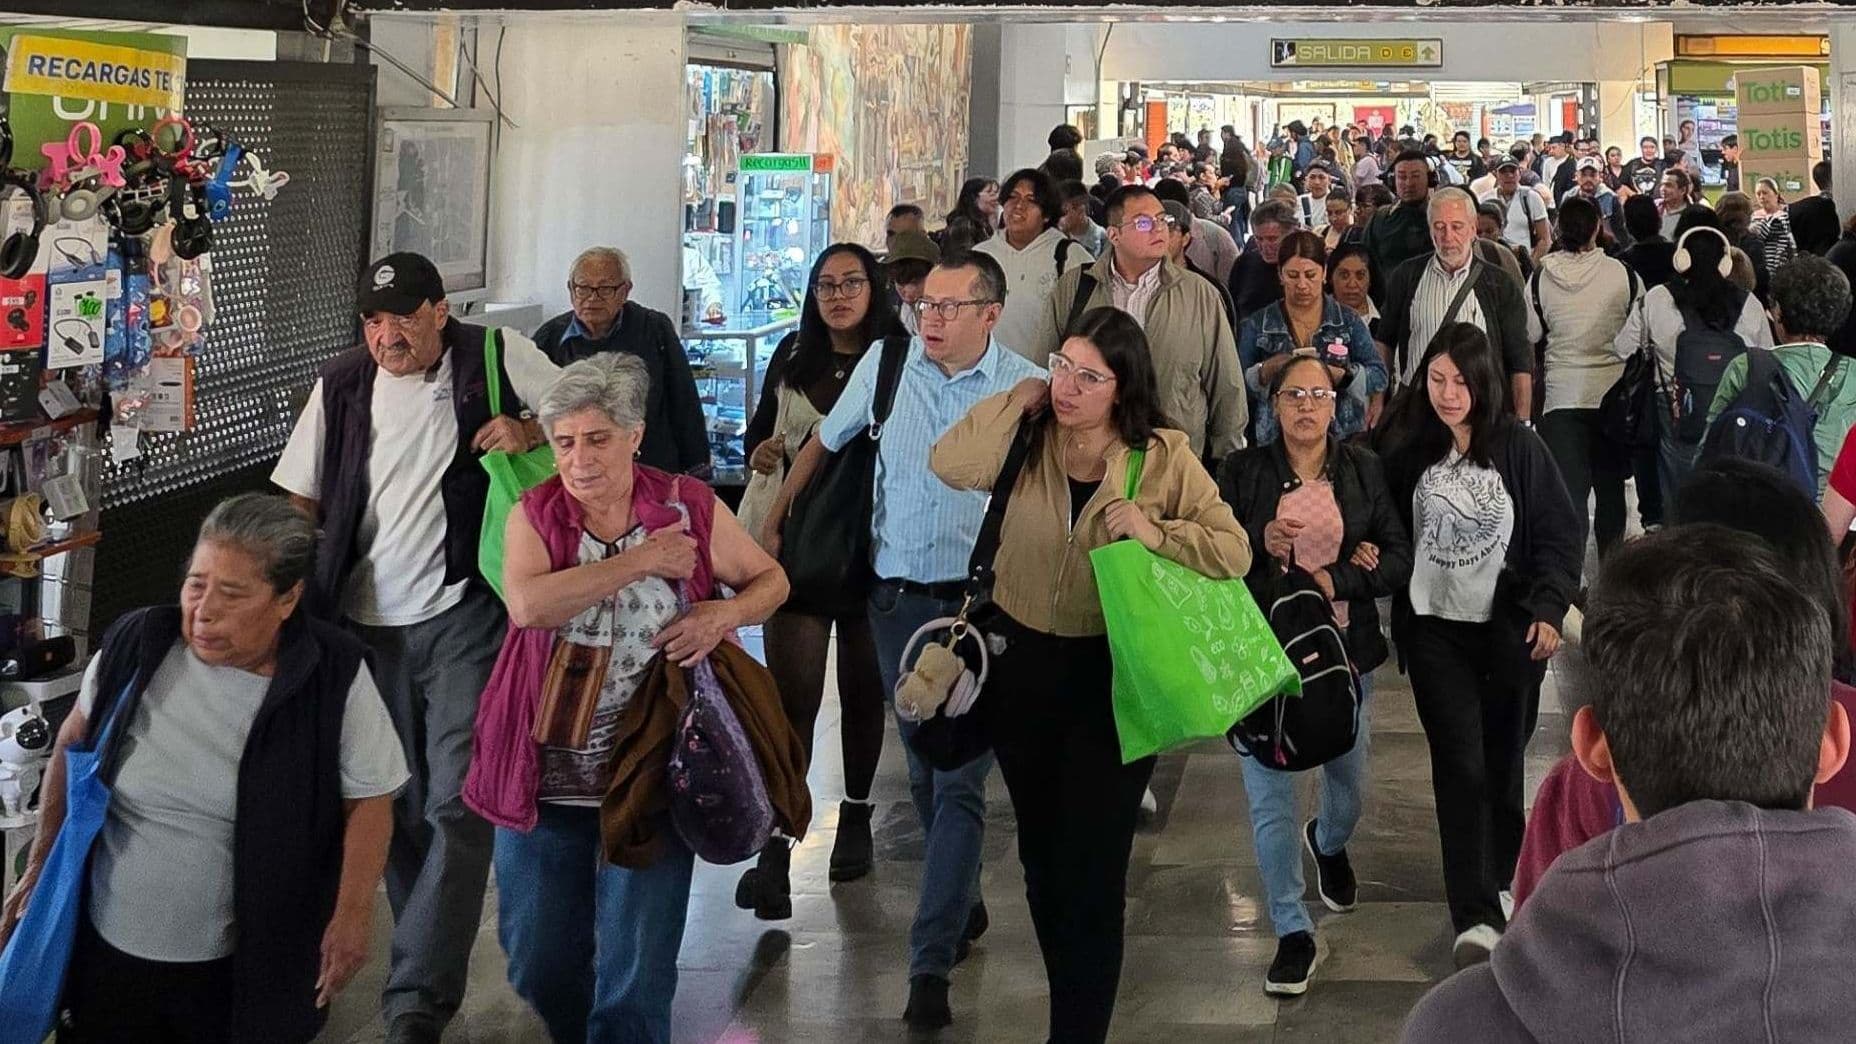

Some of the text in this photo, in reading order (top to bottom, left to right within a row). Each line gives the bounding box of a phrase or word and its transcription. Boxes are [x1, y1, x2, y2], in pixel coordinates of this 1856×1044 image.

[1299, 45, 1371, 60] SALIDA
[28, 54, 151, 89] RECARGAS
[1744, 81, 1800, 102] Toti
[1743, 127, 1802, 150] Totis
